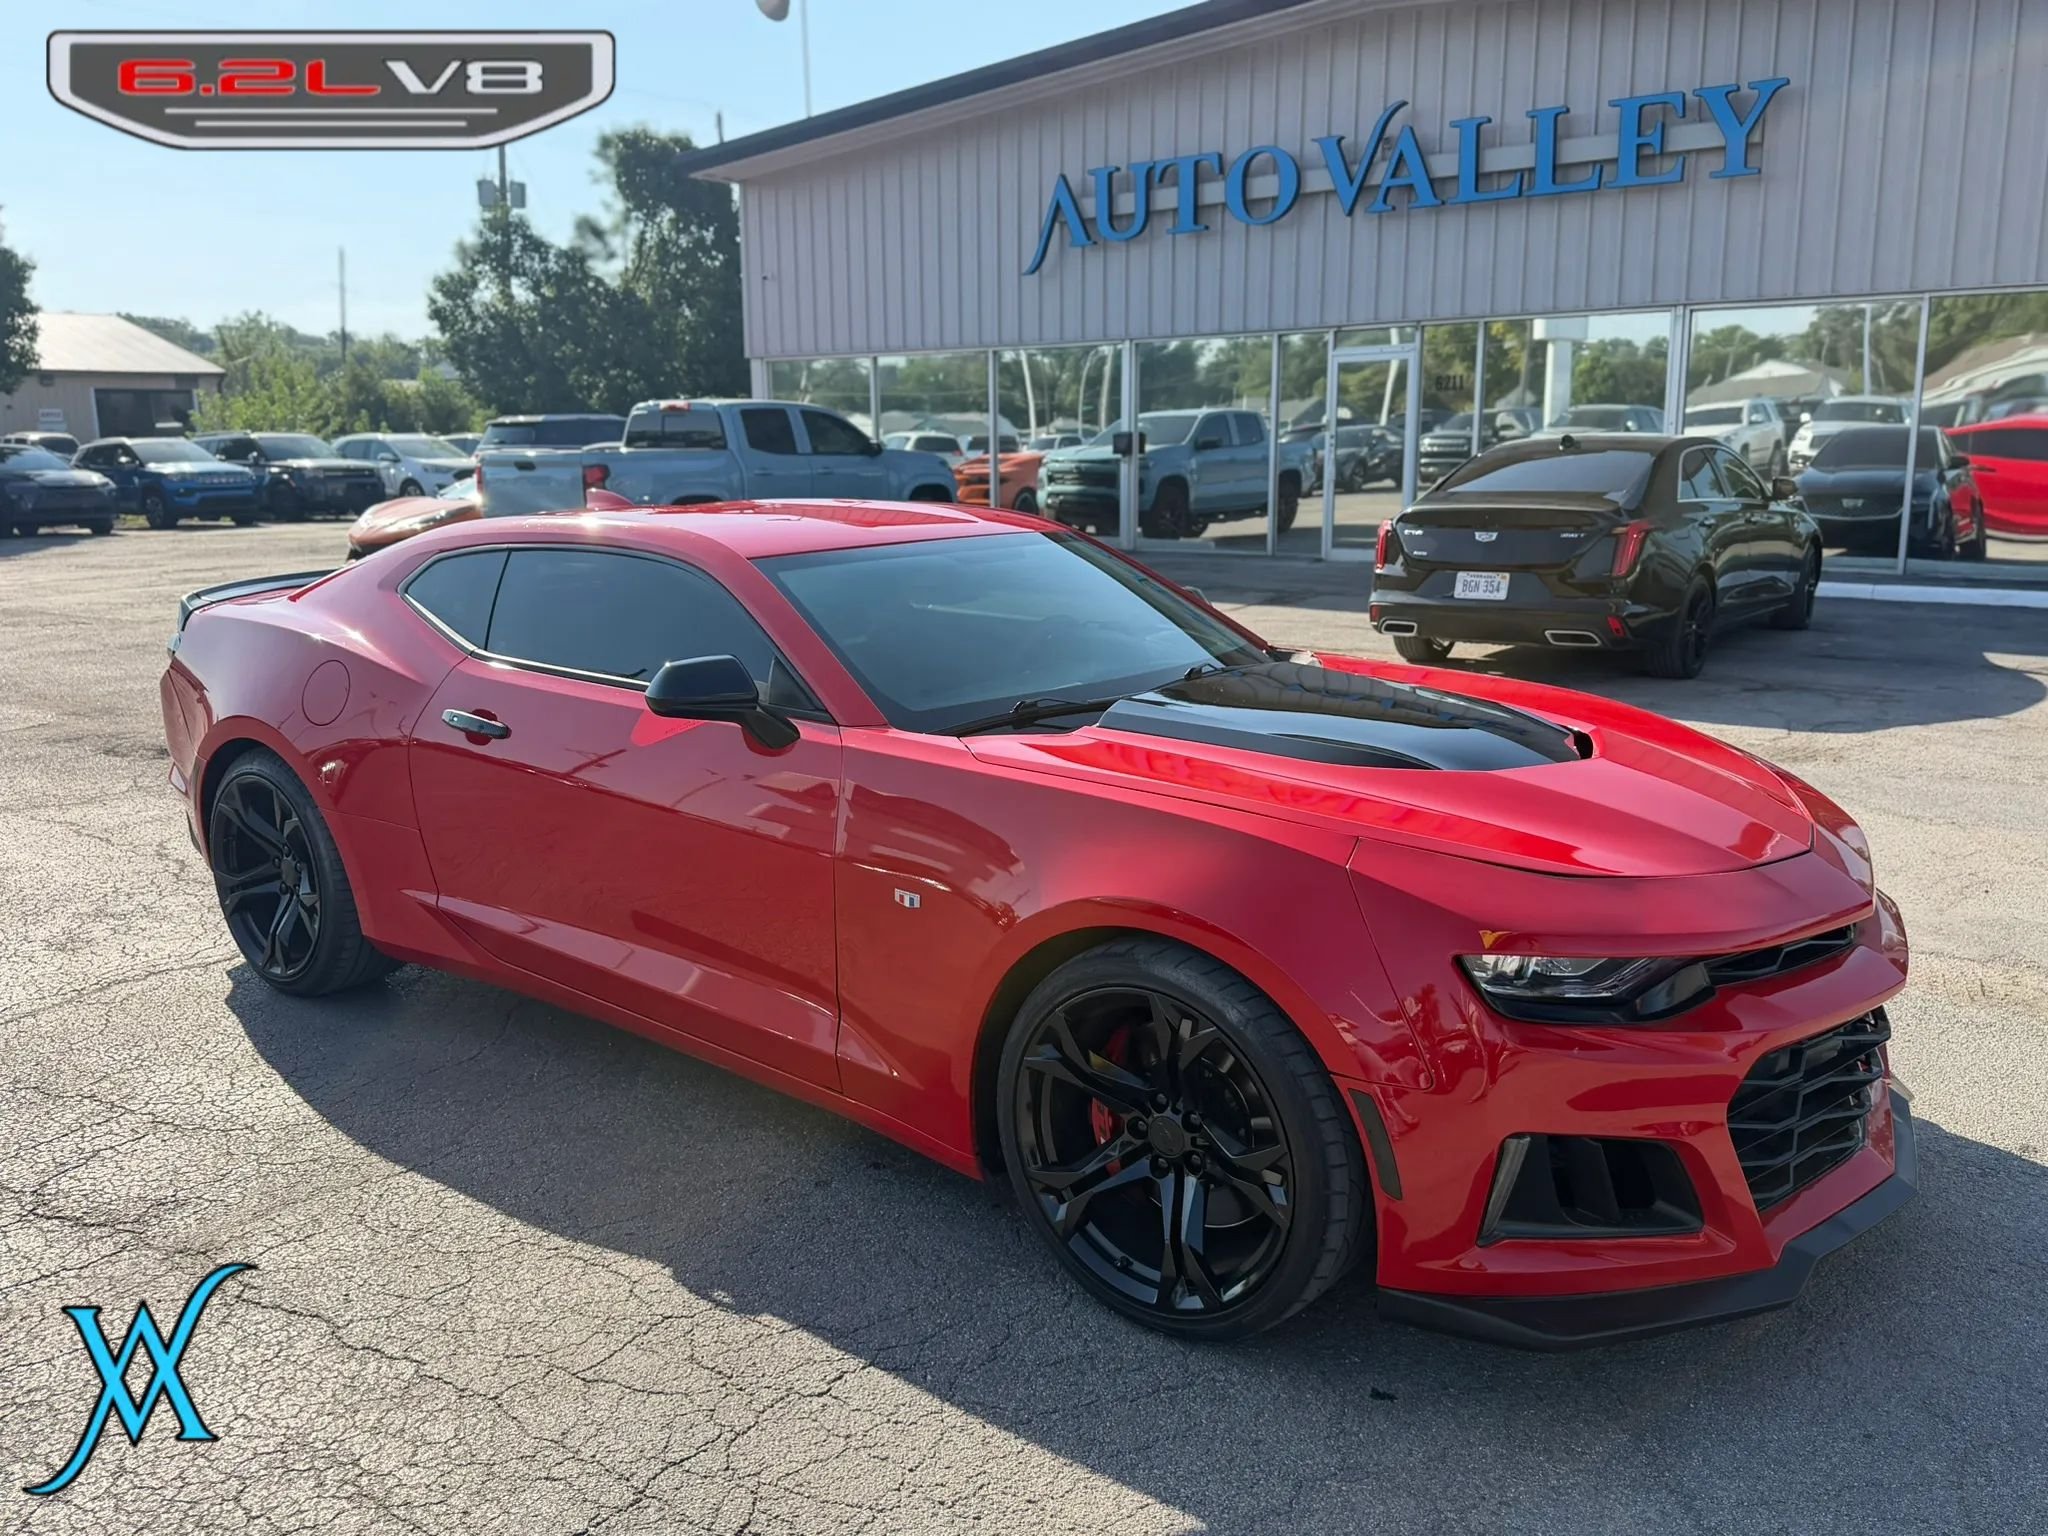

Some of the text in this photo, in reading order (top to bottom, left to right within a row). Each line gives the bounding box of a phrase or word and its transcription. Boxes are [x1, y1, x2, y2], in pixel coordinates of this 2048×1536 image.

[1022, 77, 1791, 276] AUTO VALLEY
[1462, 579, 1501, 594] BGN 354
